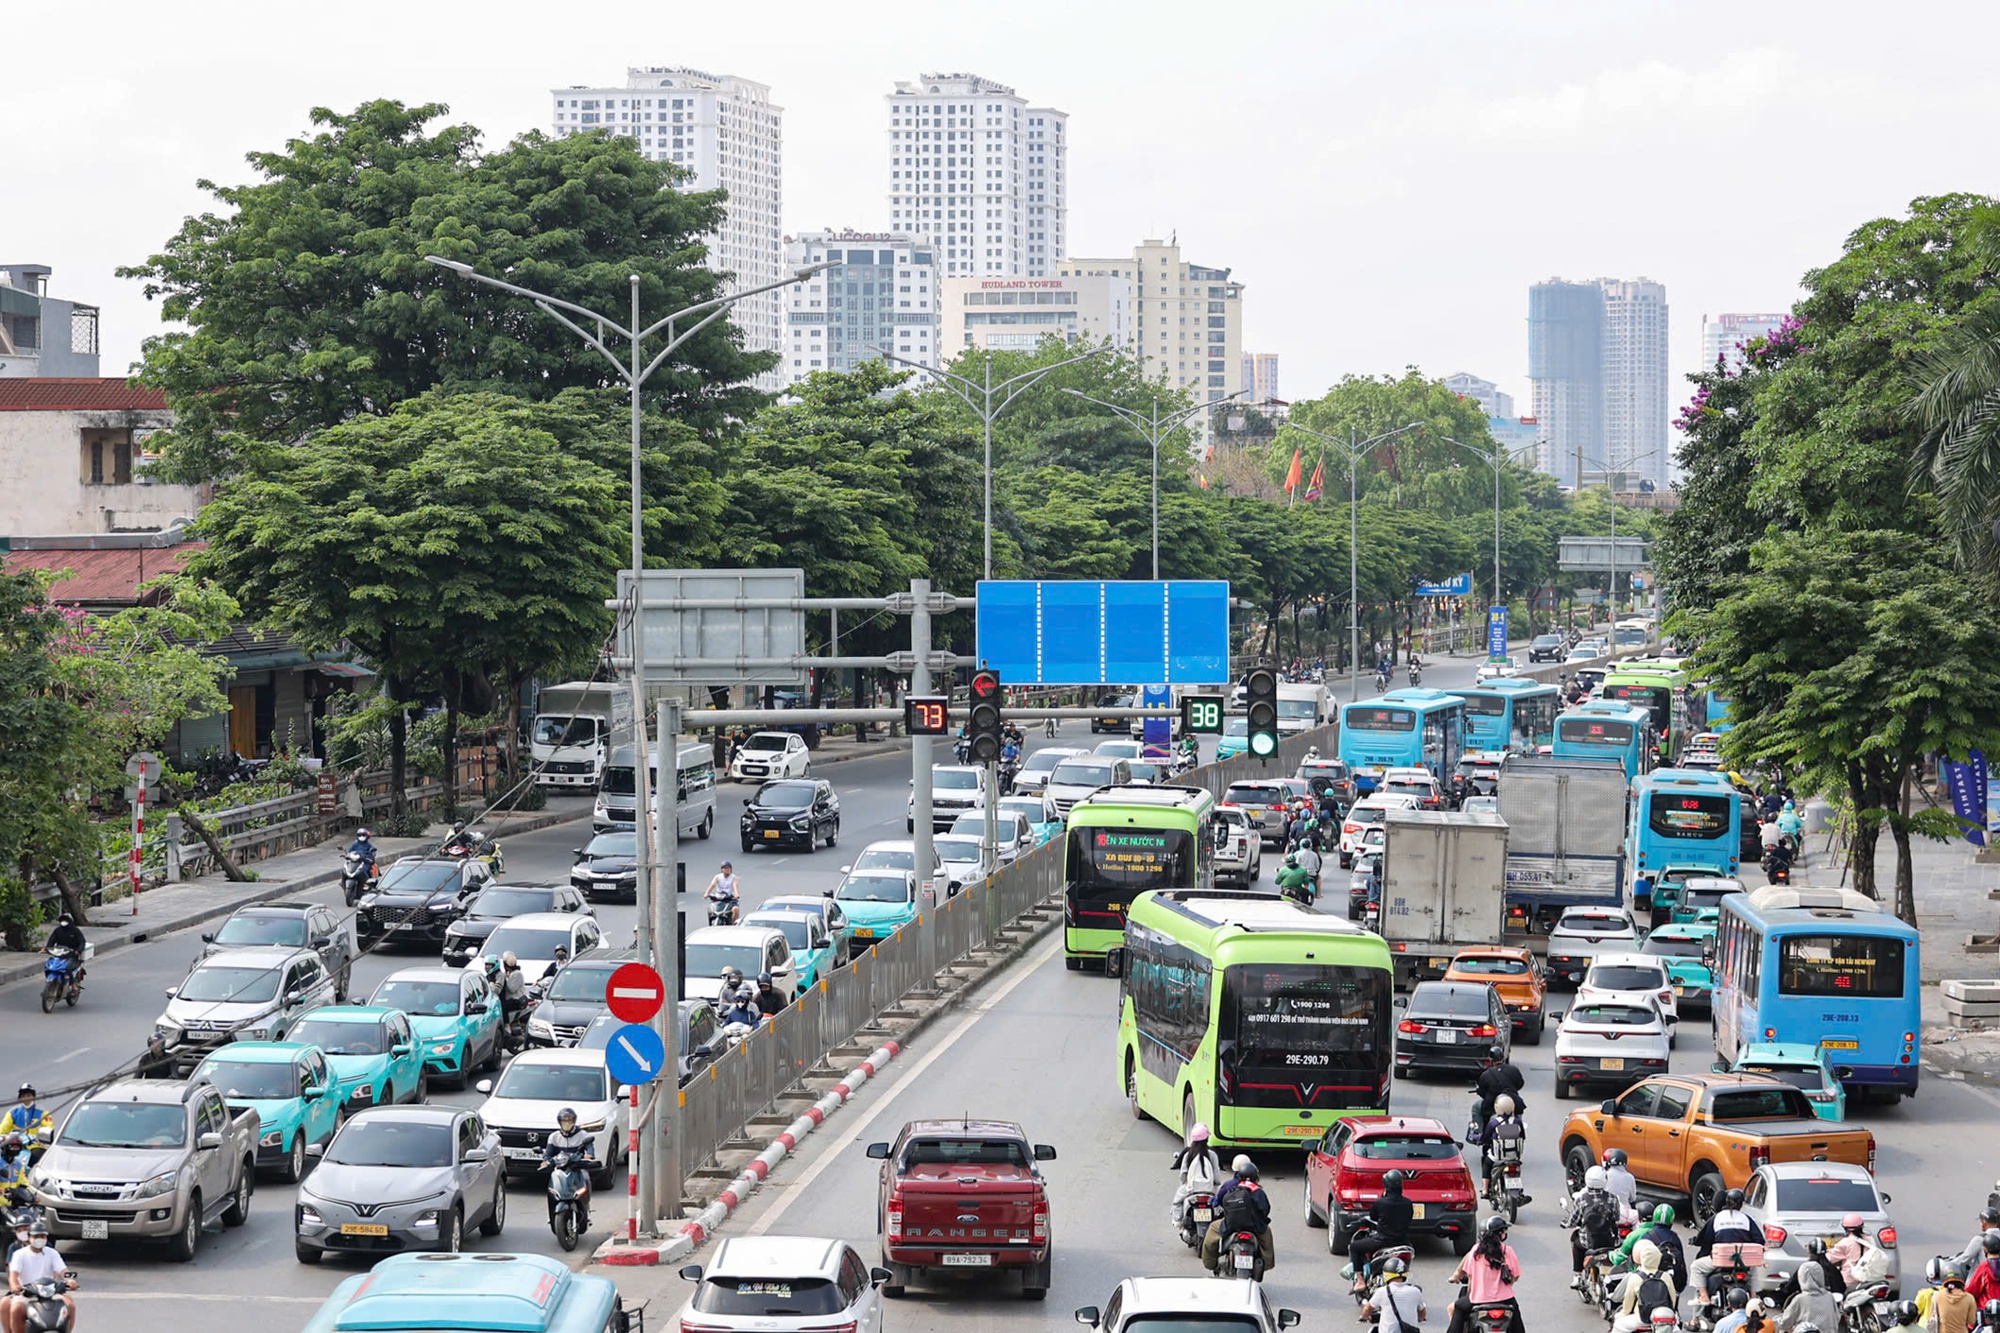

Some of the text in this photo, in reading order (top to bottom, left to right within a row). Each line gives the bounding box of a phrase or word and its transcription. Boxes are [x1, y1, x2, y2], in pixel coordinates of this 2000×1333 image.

[981, 281, 1026, 289] HUDLAND
[916, 704, 942, 728] 73
[1191, 703, 1218, 727] 38
[1954, 767, 1971, 814] VINFAST
[1118, 837, 1128, 845] XE
[1256, 1014, 1270, 1022] 0917
[1286, 1055, 1329, 1065] 29E-290.79
[82, 1185, 112, 1193] ISUZU
[907, 1228, 1029, 1237] RANGER
